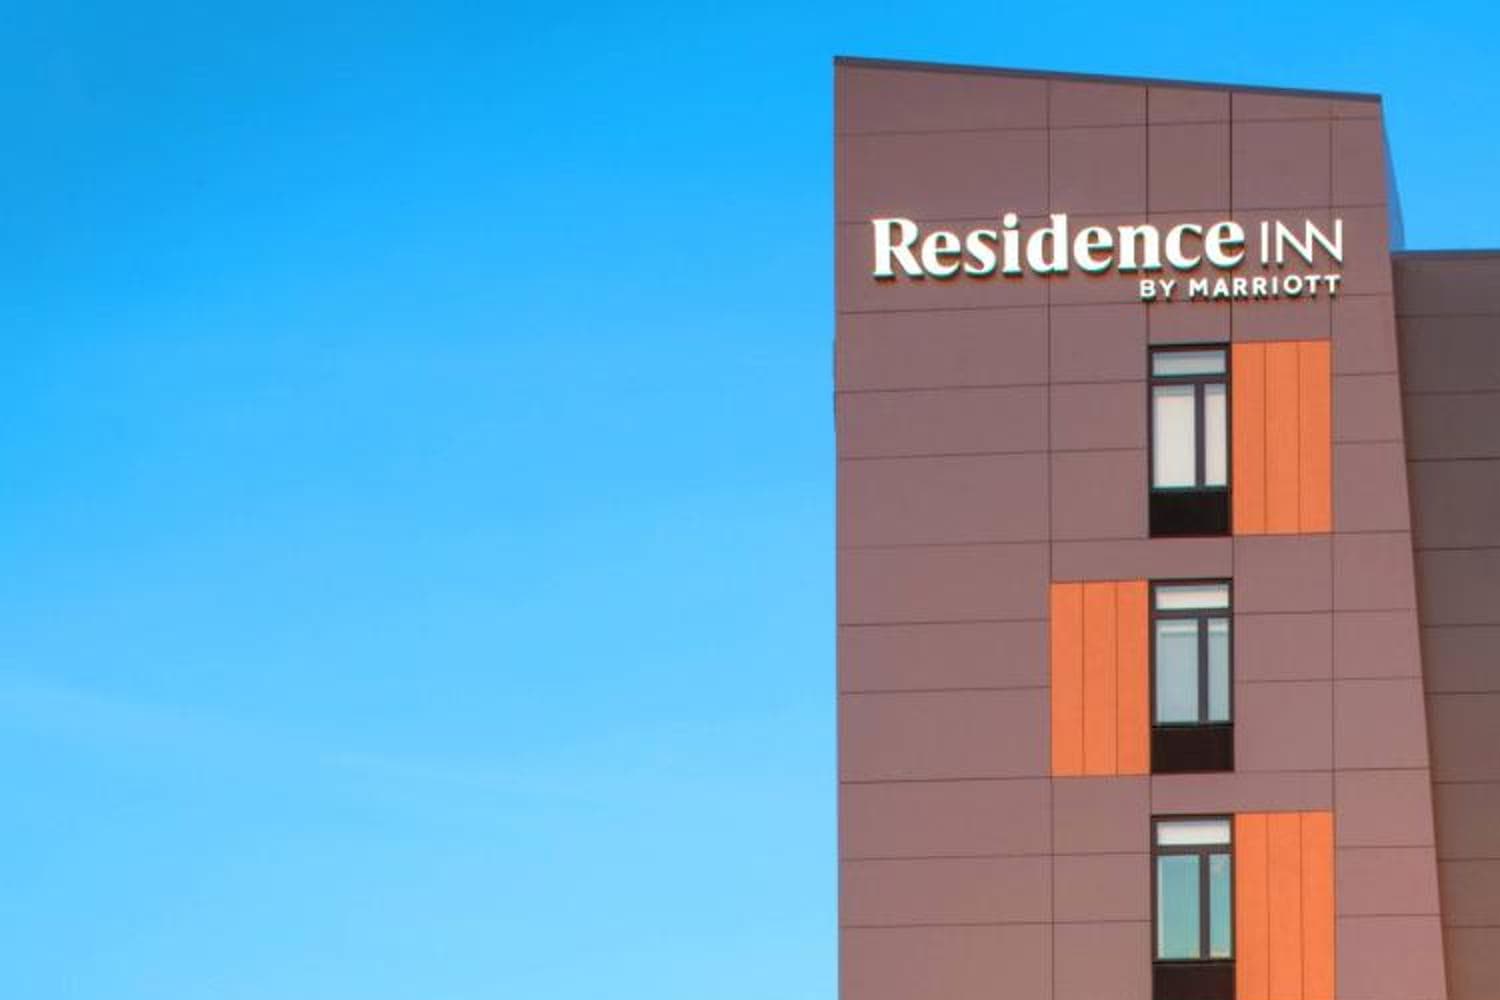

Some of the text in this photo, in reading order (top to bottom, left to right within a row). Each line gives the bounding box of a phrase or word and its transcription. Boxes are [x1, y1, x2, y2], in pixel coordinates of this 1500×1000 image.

[872, 212, 1344, 278] Residence INN
[1139, 274, 1342, 299] BY MARRIOTT
